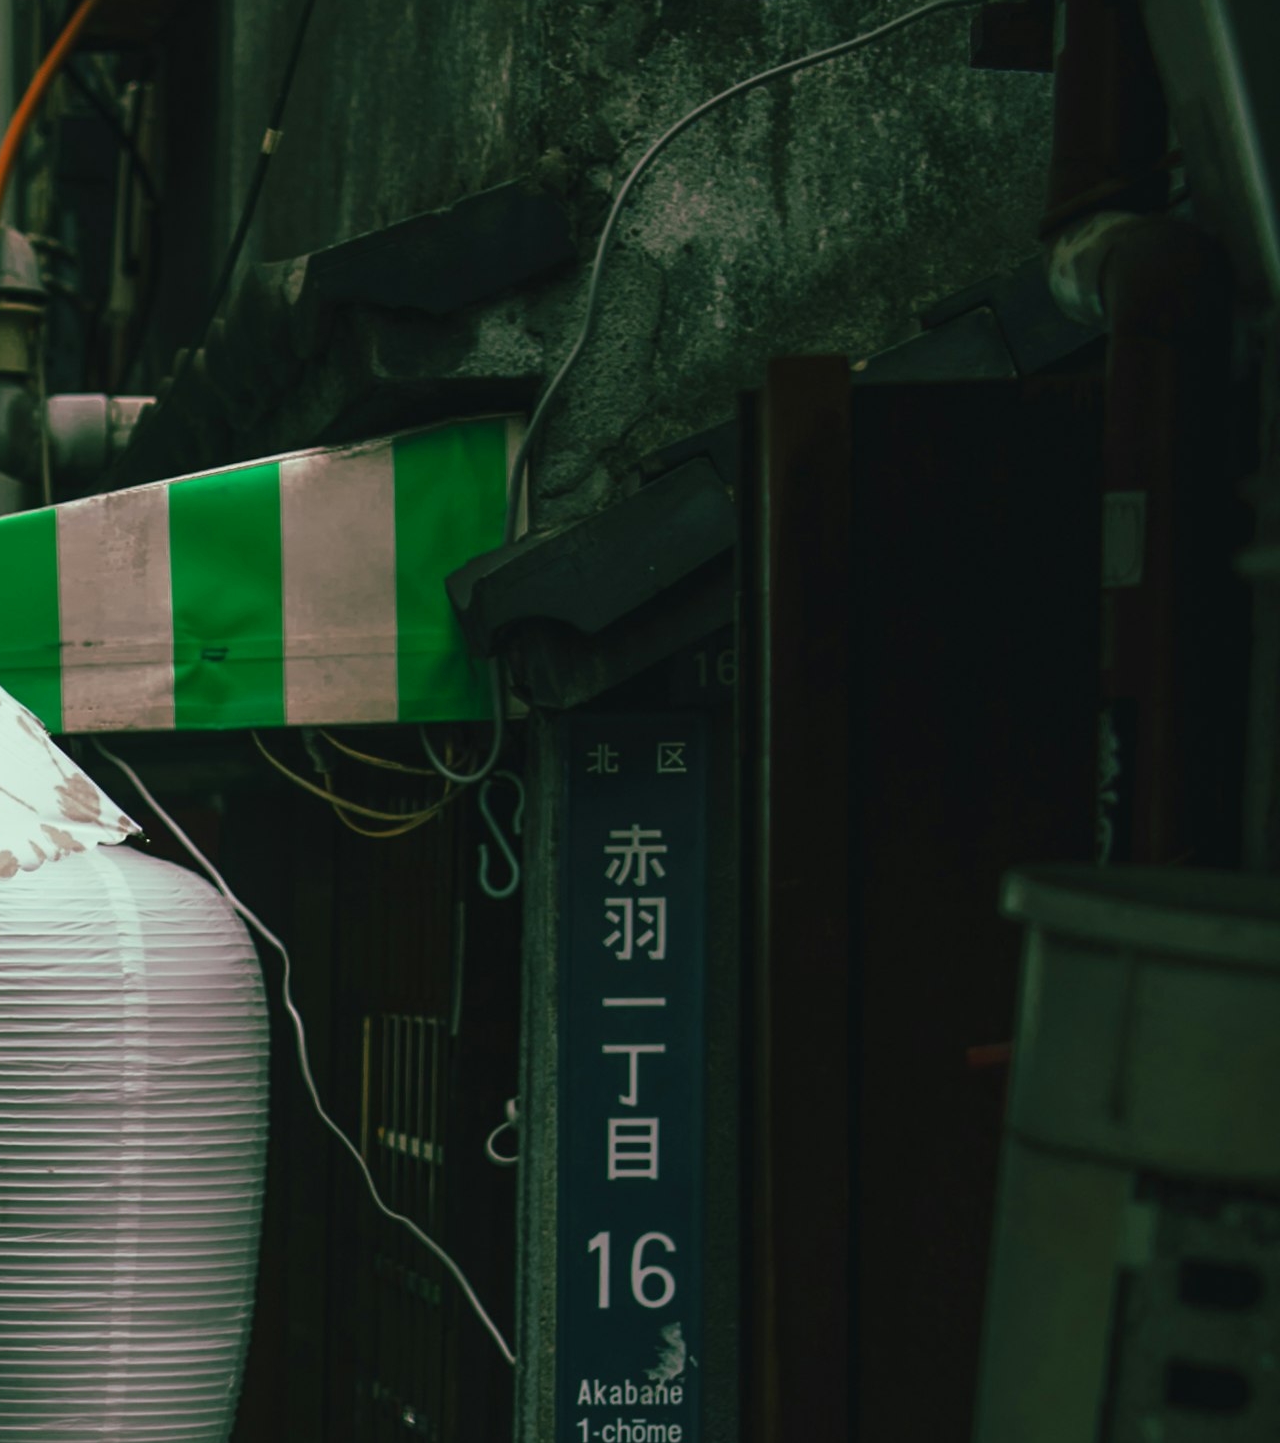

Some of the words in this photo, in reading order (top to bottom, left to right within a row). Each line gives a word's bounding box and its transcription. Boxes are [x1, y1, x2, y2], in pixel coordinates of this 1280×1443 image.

[586, 741, 688, 774] 北区
[601, 823, 668, 1181] 赤羽一丁目
[587, 1230, 678, 1310] 16
[576, 1378, 684, 1406] Akabane
